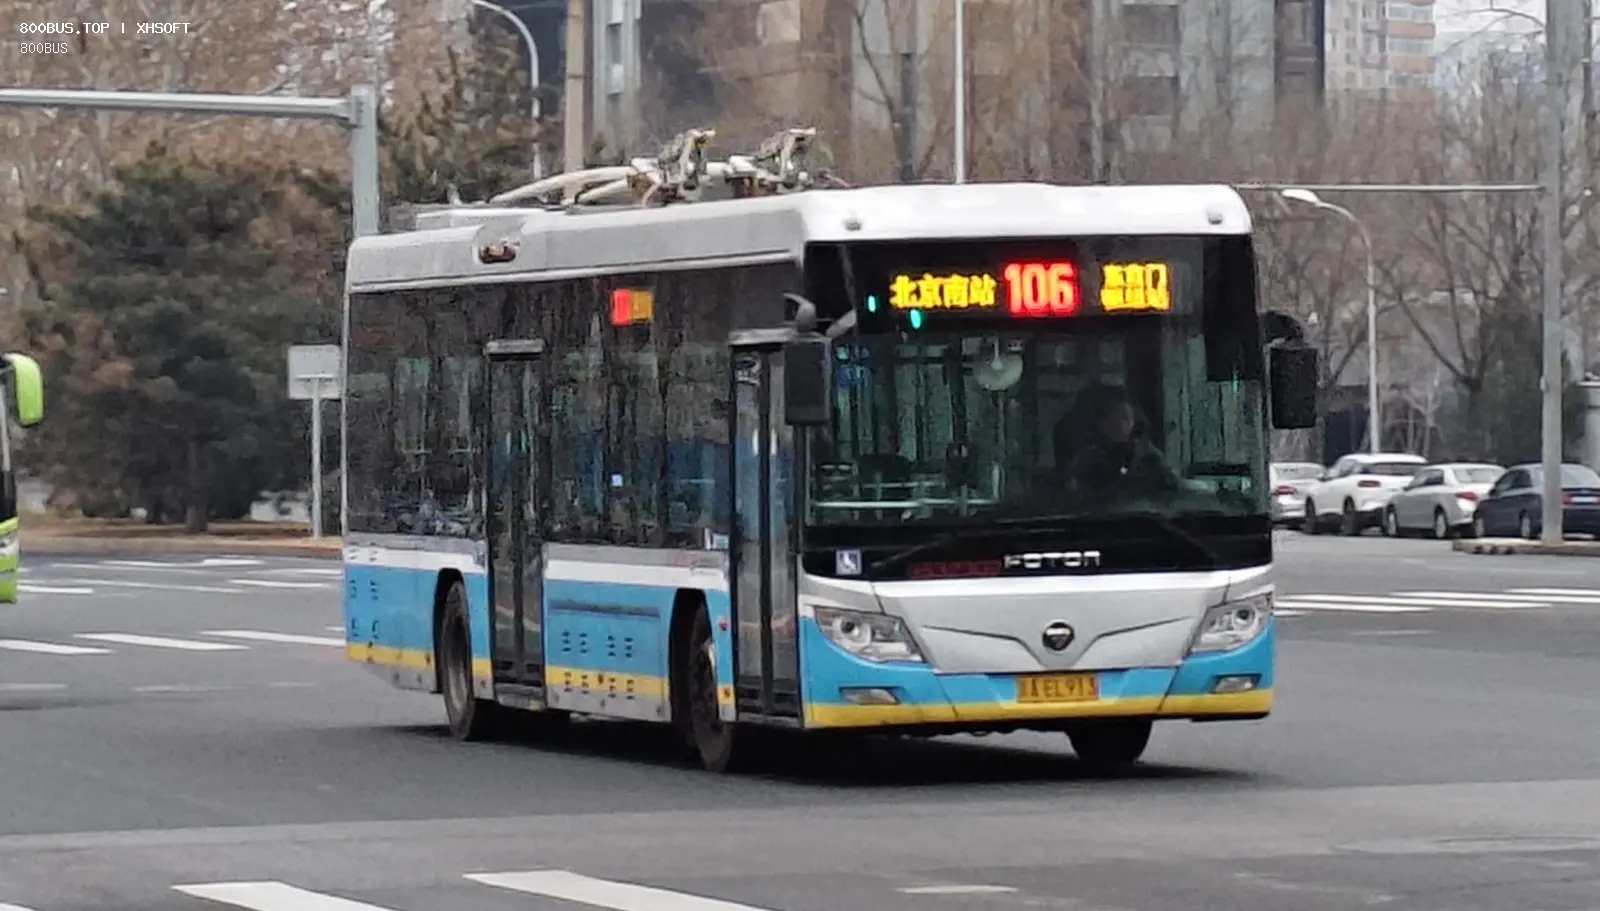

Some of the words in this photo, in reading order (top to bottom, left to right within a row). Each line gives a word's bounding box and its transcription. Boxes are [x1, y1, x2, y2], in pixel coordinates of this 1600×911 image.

[888, 273, 998, 309] 北京南站
[1003, 261, 1077, 315] 106
[1004, 551, 1101, 569] FOTON
